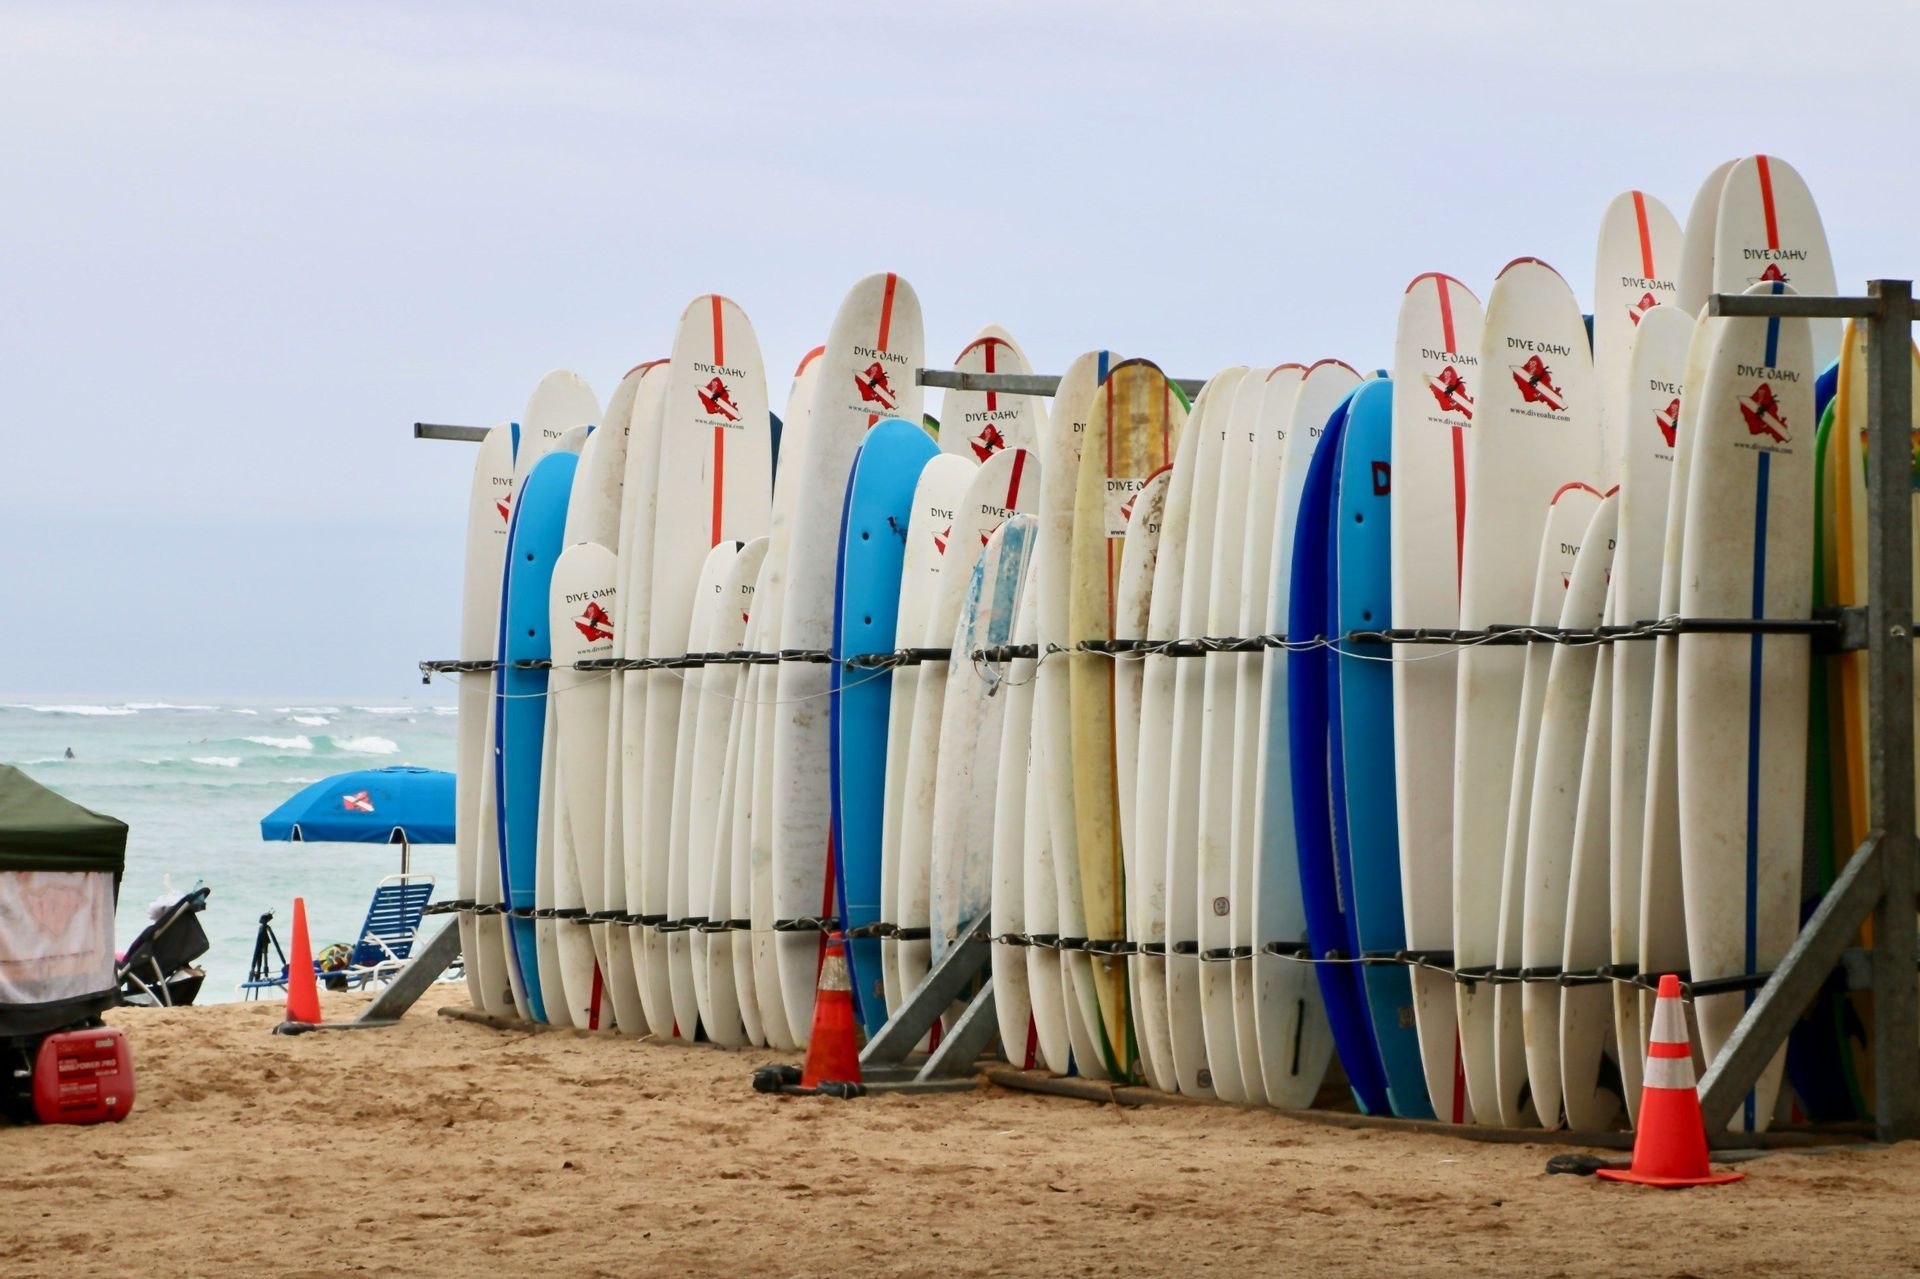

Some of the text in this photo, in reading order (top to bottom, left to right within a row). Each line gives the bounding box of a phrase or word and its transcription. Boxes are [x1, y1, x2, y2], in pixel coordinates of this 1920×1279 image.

[1743, 248, 1808, 261] DIVE OAHU
[1621, 276, 1646, 289] DIVE
[1507, 337, 1571, 357] DIVE OAHU
[853, 345, 909, 365] DIVE OAHU
[1421, 348, 1447, 362] DIVE
[694, 362, 746, 378] DIVE OAHU
[1737, 364, 1800, 383] DIVE OAHU
[1650, 379, 1675, 394] DIVE
[965, 410, 1019, 422] DIVE OAHU
[1510, 407, 1571, 422] www.diveoahu.com
[492, 477, 513, 487] DIVE
[1107, 481, 1133, 491] DIVE
[931, 507, 953, 520] DIVE
[981, 504, 1005, 518] DIVE
[565, 592, 590, 604] DIVE
